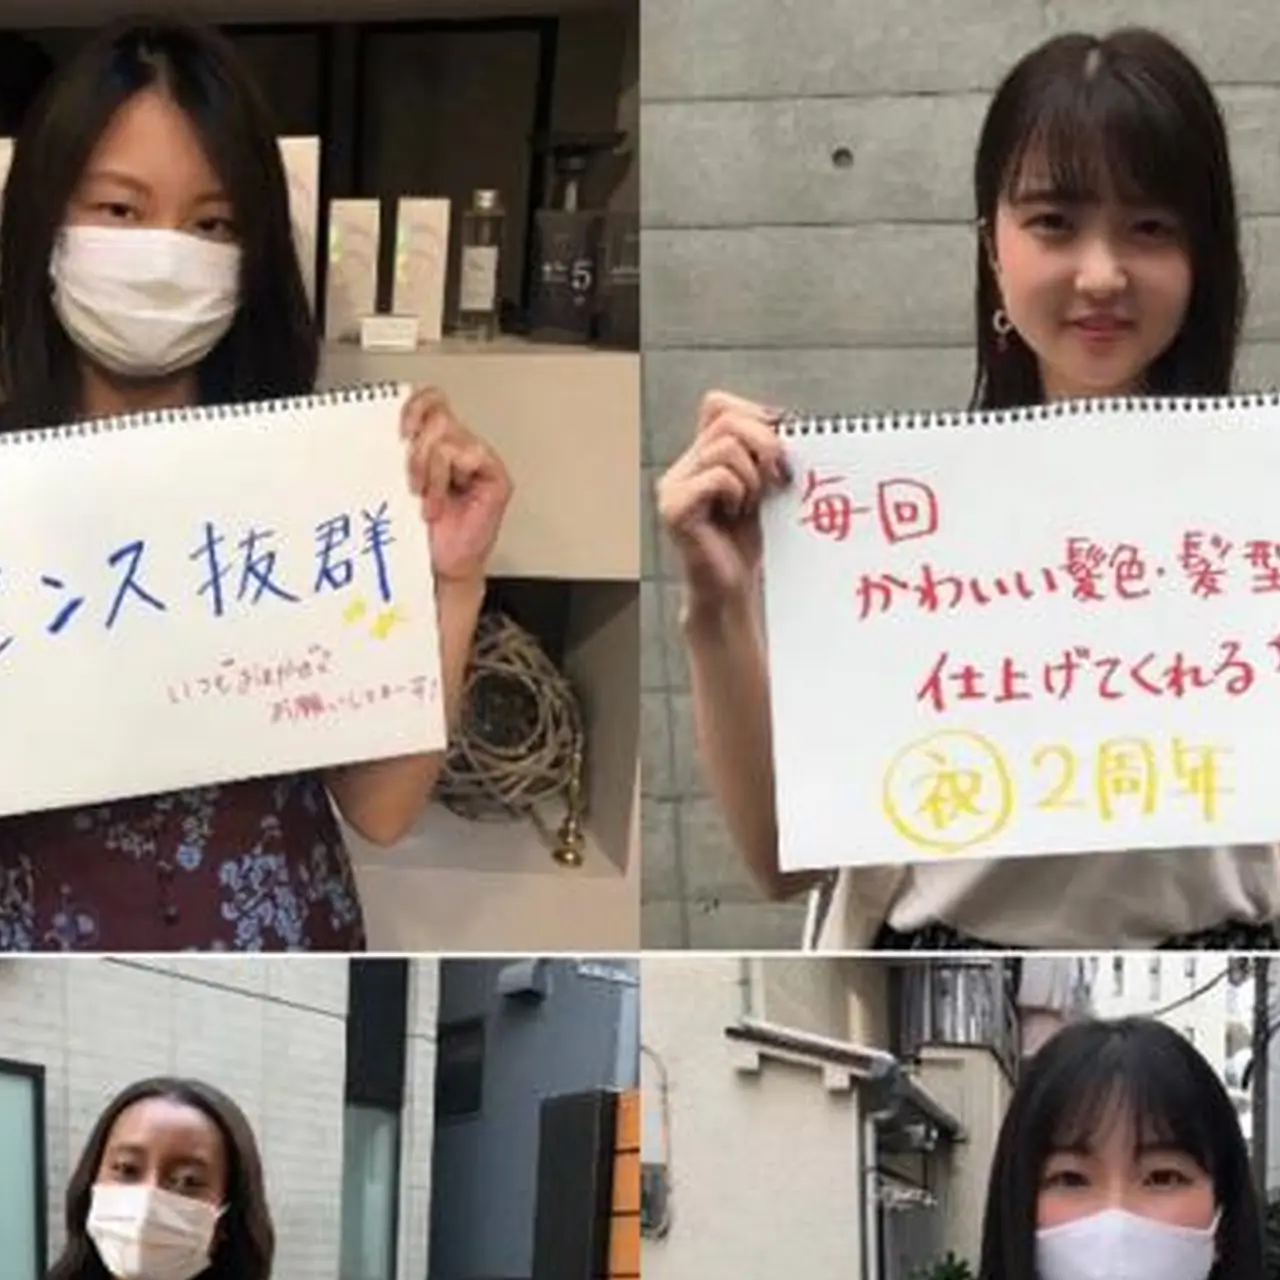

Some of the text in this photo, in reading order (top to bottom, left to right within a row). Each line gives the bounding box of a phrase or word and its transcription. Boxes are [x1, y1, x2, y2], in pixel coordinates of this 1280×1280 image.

[799, 469, 939, 545] 毎回
[917, 640, 1255, 712] 仕上げてくれる
